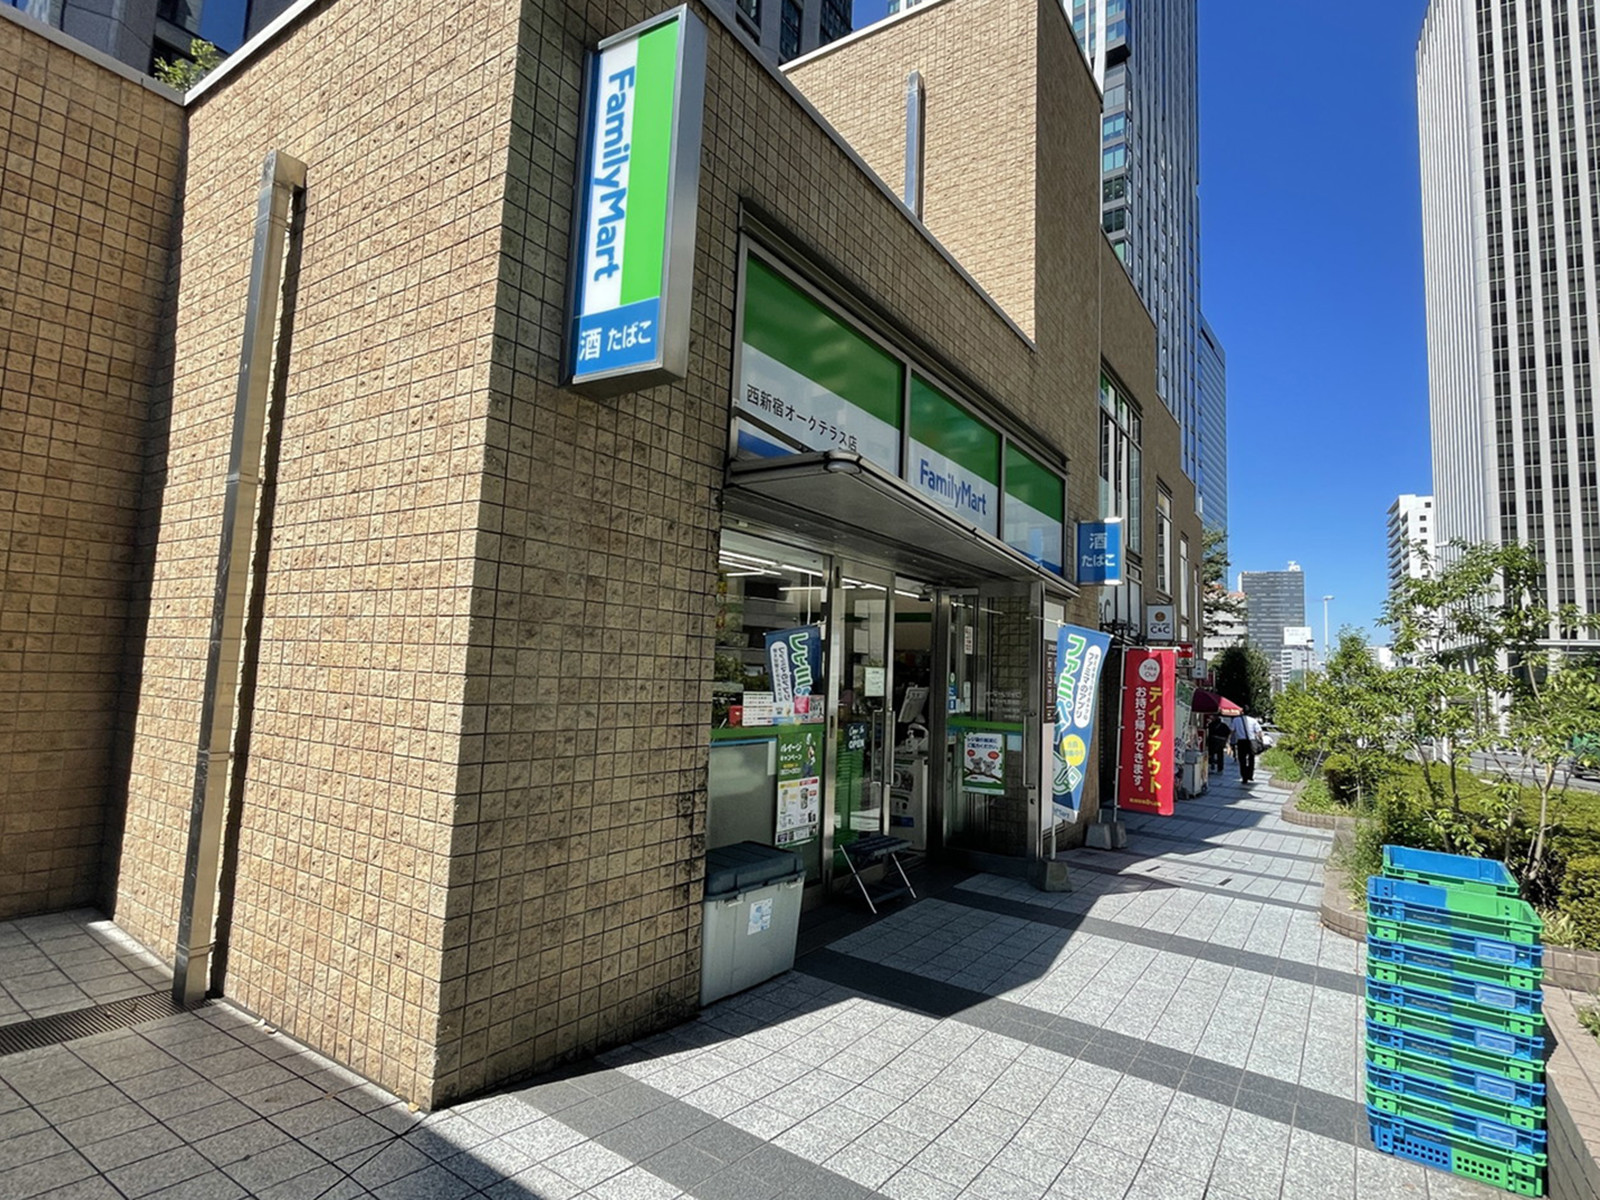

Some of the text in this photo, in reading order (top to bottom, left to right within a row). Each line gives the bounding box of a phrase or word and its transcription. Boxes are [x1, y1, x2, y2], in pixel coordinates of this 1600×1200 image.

[593, 66, 635, 282] FamilyMart
[578, 321, 652, 361] 酒 たばこ
[746, 384, 858, 452] 西新宿オークテラス店
[920, 458, 987, 516] FamilyMart
[1080, 553, 1116, 568] たばこ
[1089, 532, 1108, 550] 酒
[1133, 686, 1147, 792] お持ち帰りできます。
[1148, 686, 1162, 793] テイクアウト
